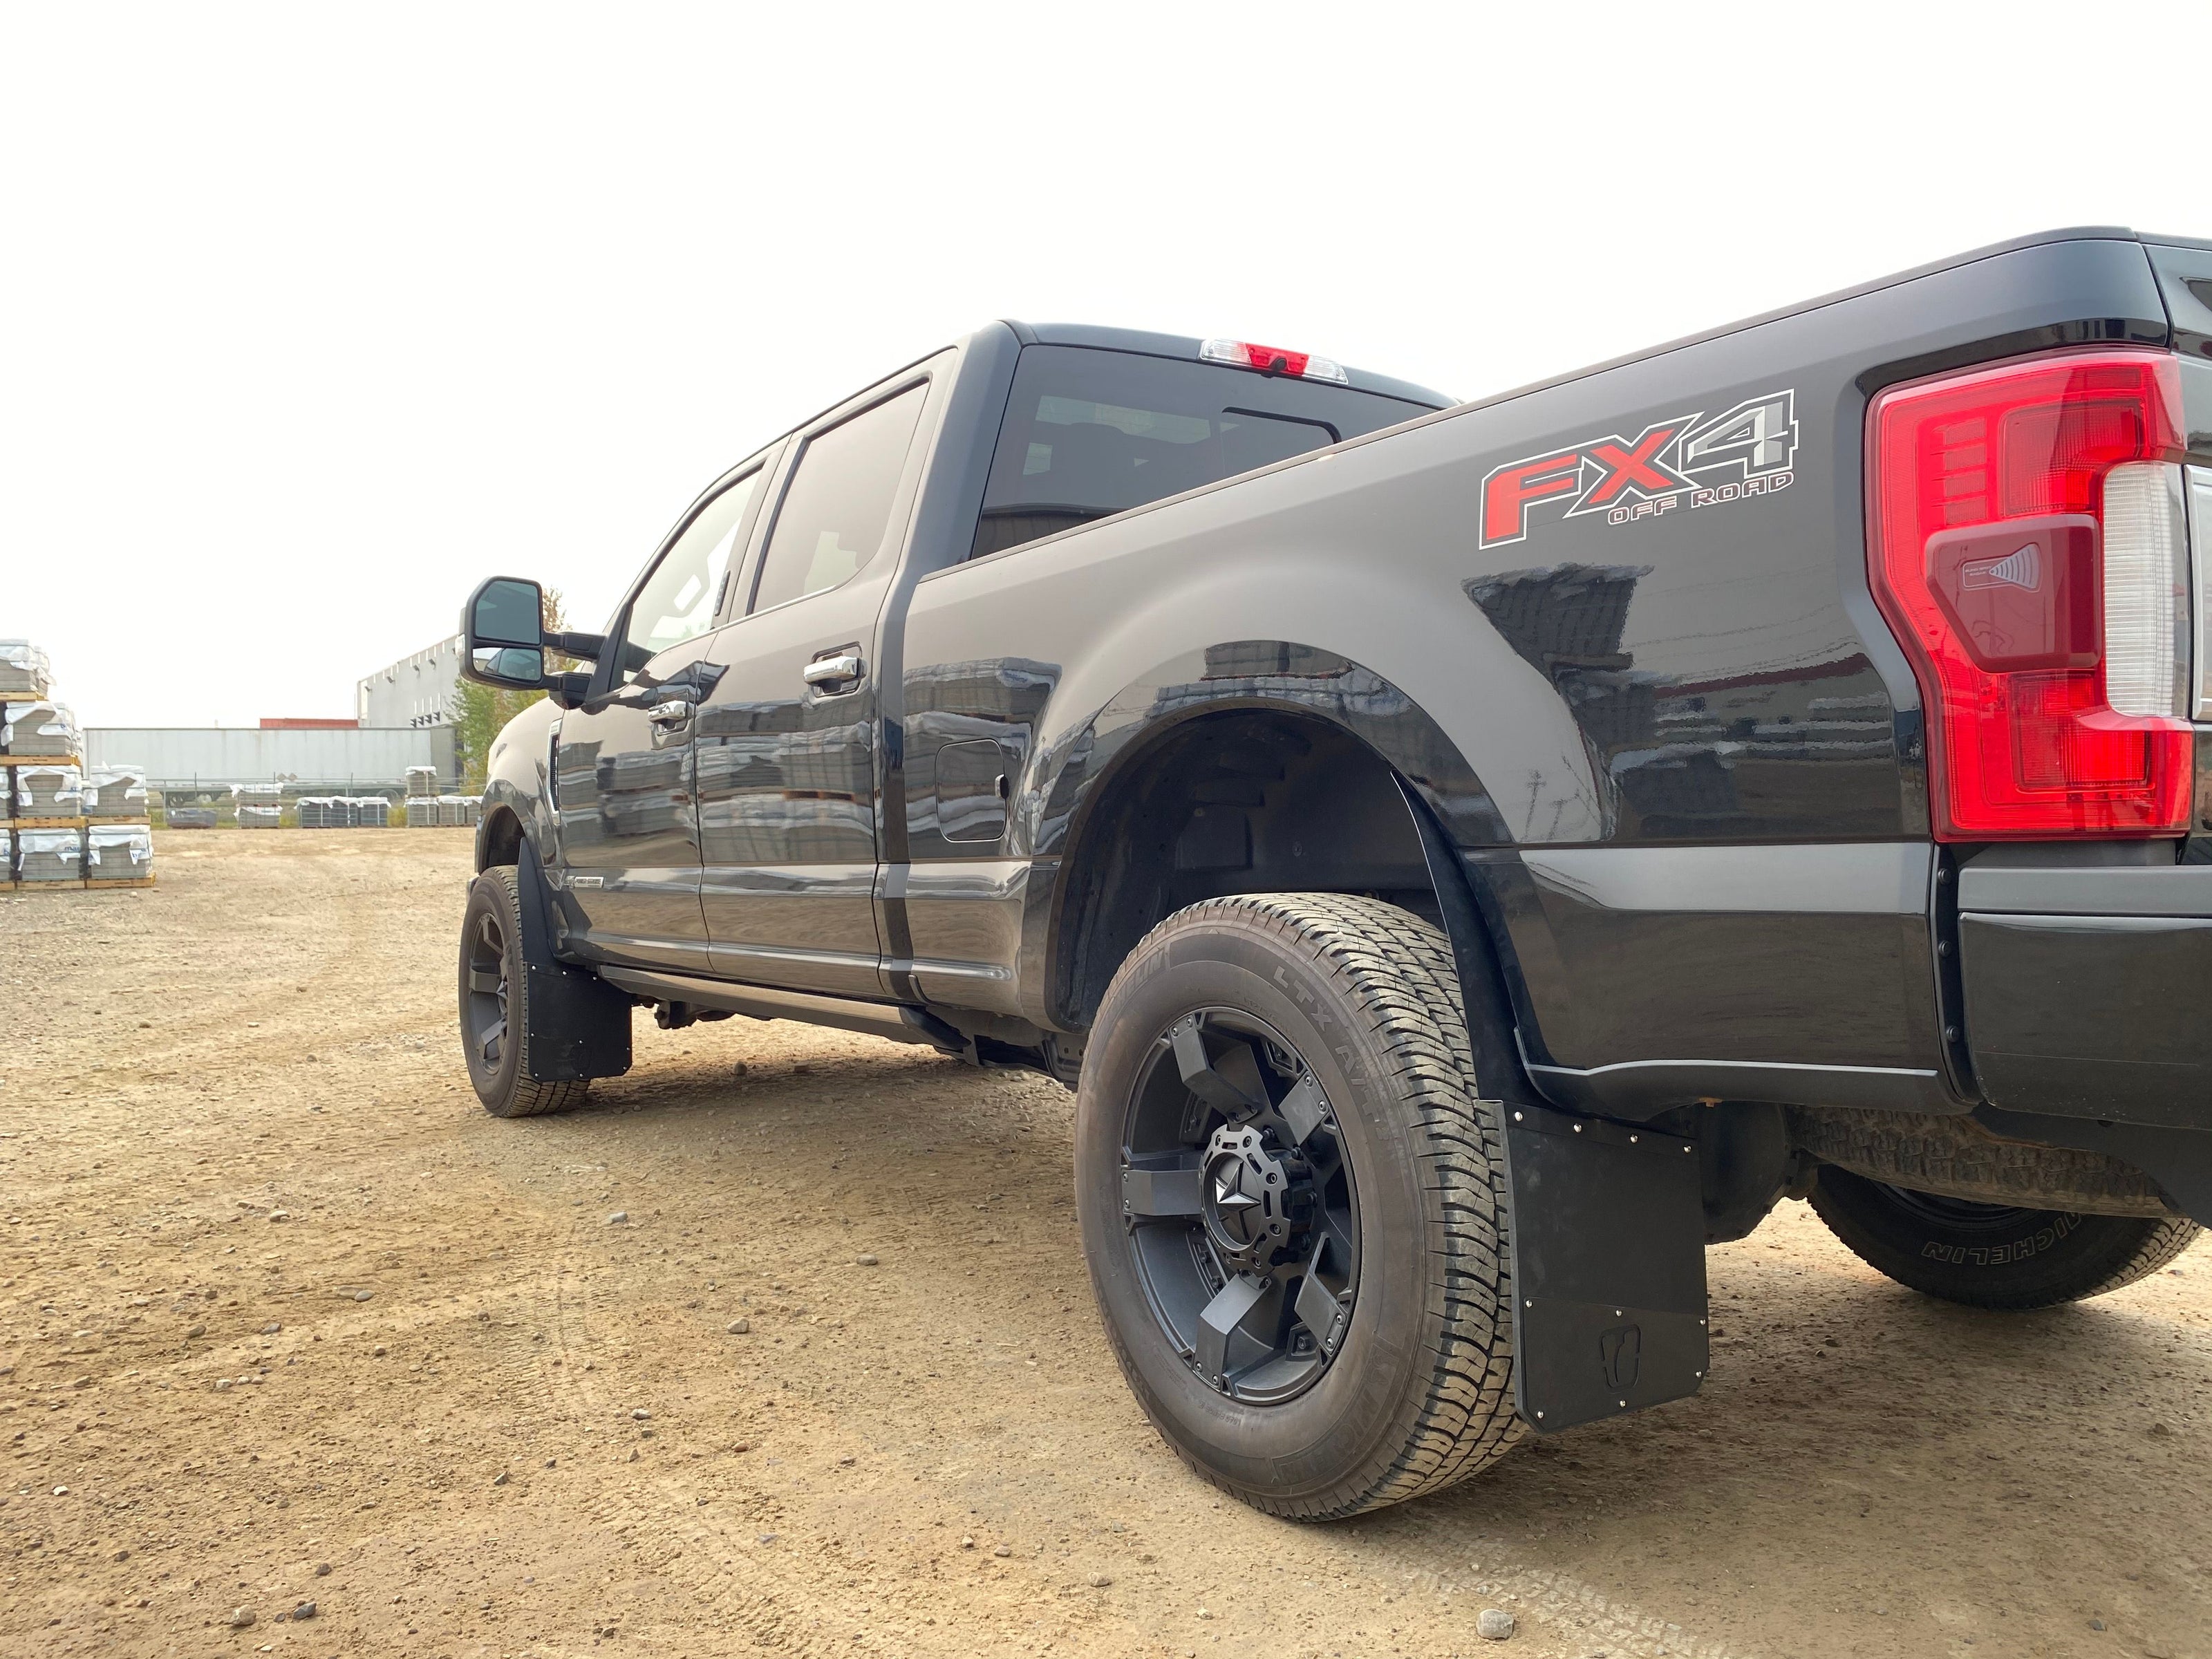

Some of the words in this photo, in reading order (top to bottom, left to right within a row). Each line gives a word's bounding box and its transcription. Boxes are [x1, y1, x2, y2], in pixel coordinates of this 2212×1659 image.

[1479, 388, 1799, 550] FX4
[1608, 495, 1678, 525] OFF
[1691, 471, 1794, 509] ROAD
[1273, 965, 1333, 1032] LTX
